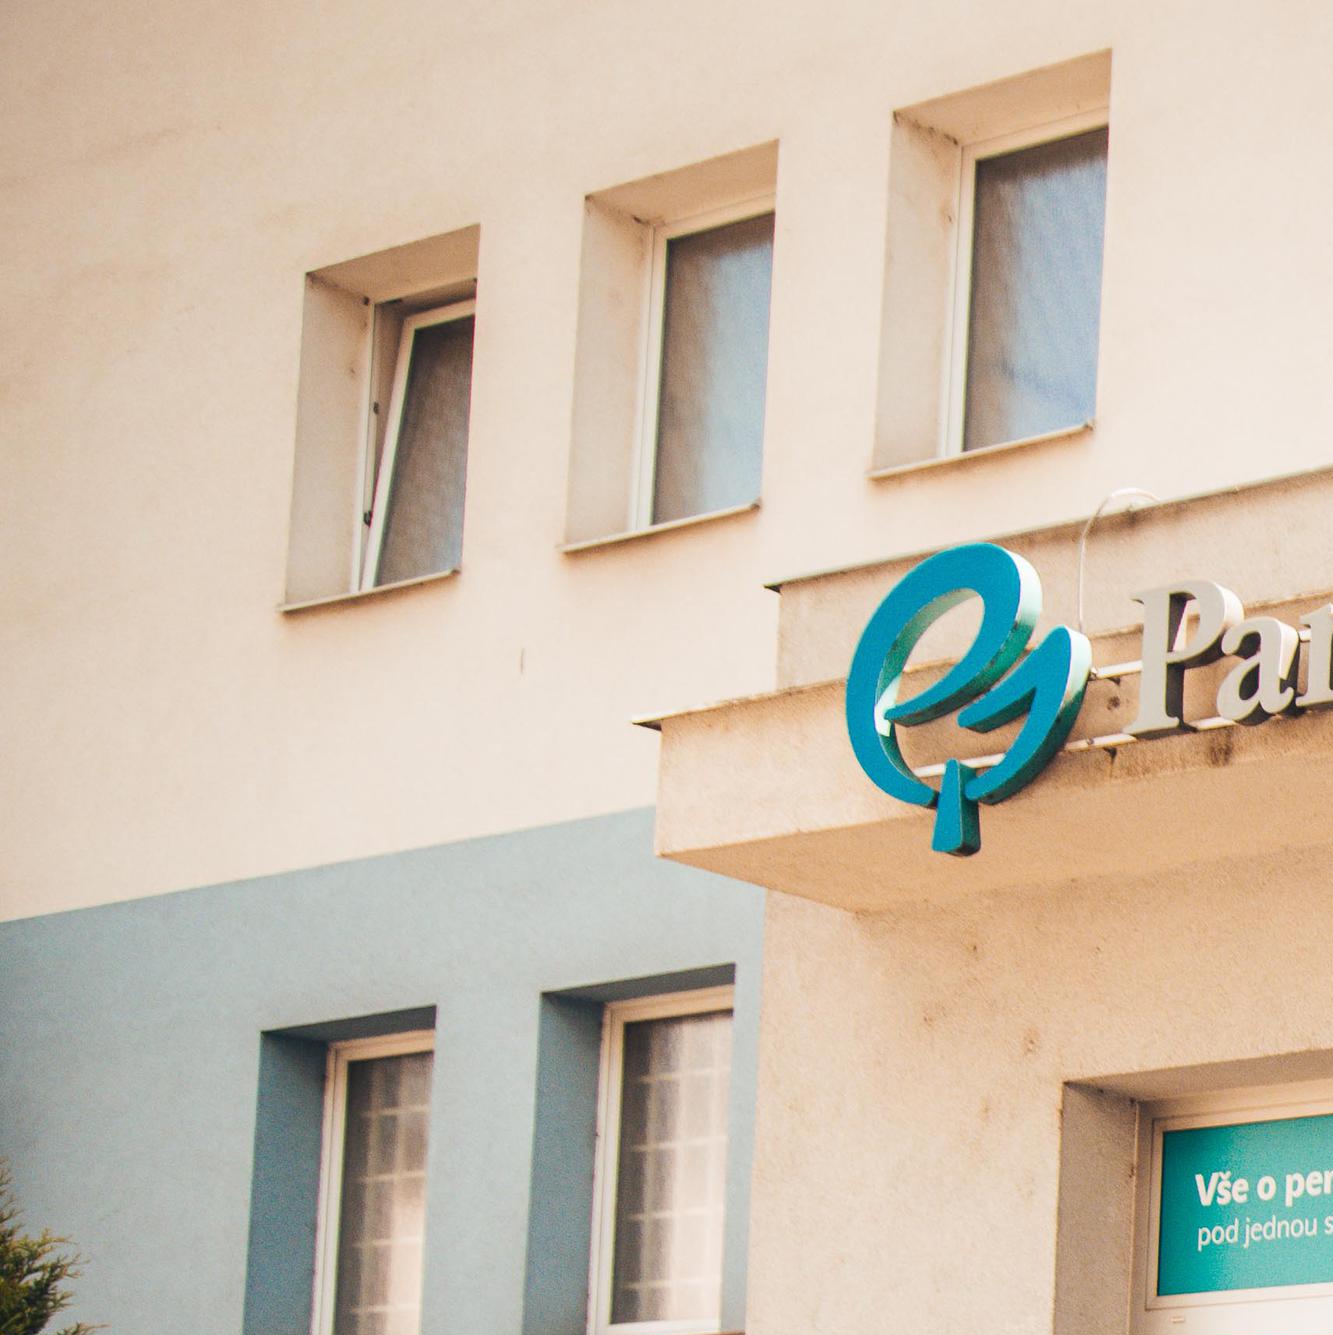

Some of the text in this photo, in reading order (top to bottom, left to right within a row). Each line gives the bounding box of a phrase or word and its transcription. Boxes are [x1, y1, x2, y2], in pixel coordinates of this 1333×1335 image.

[1195, 1172, 1248, 1207] Vše
[1257, 1176, 1277, 1201] o
[1198, 1218, 1239, 1252] pod
[1243, 1215, 1318, 1249] jednou
